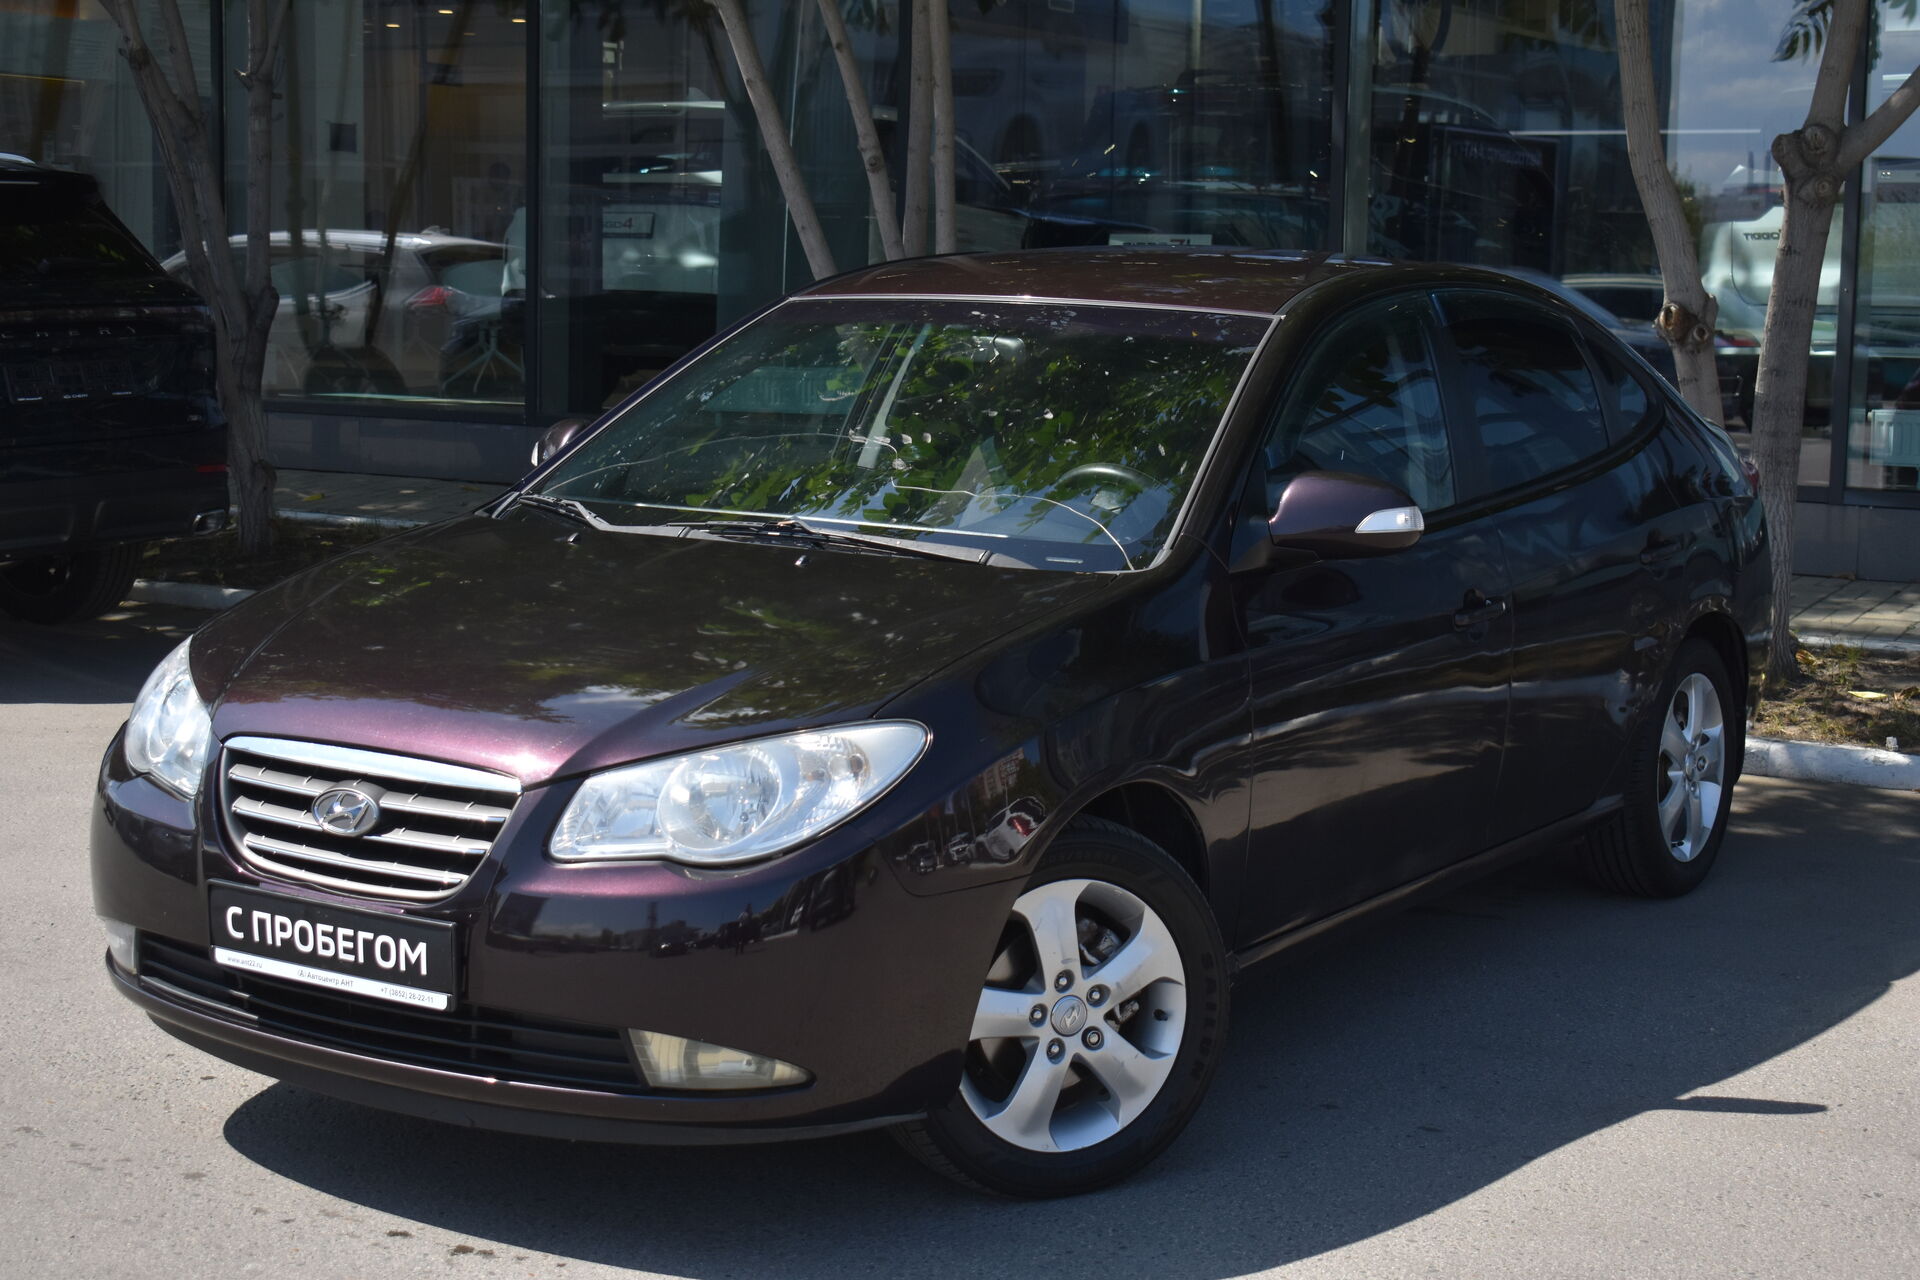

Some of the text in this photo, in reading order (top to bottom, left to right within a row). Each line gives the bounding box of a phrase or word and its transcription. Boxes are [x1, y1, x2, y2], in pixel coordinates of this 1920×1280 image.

[226, 905, 428, 976] С ПРОБЕГОМ
[227, 956, 263, 969] www.ant22.ru
[307, 971, 340, 986] Автоцентр
[340, 978, 354, 988] АНТ
[380, 987, 388, 995] +7
